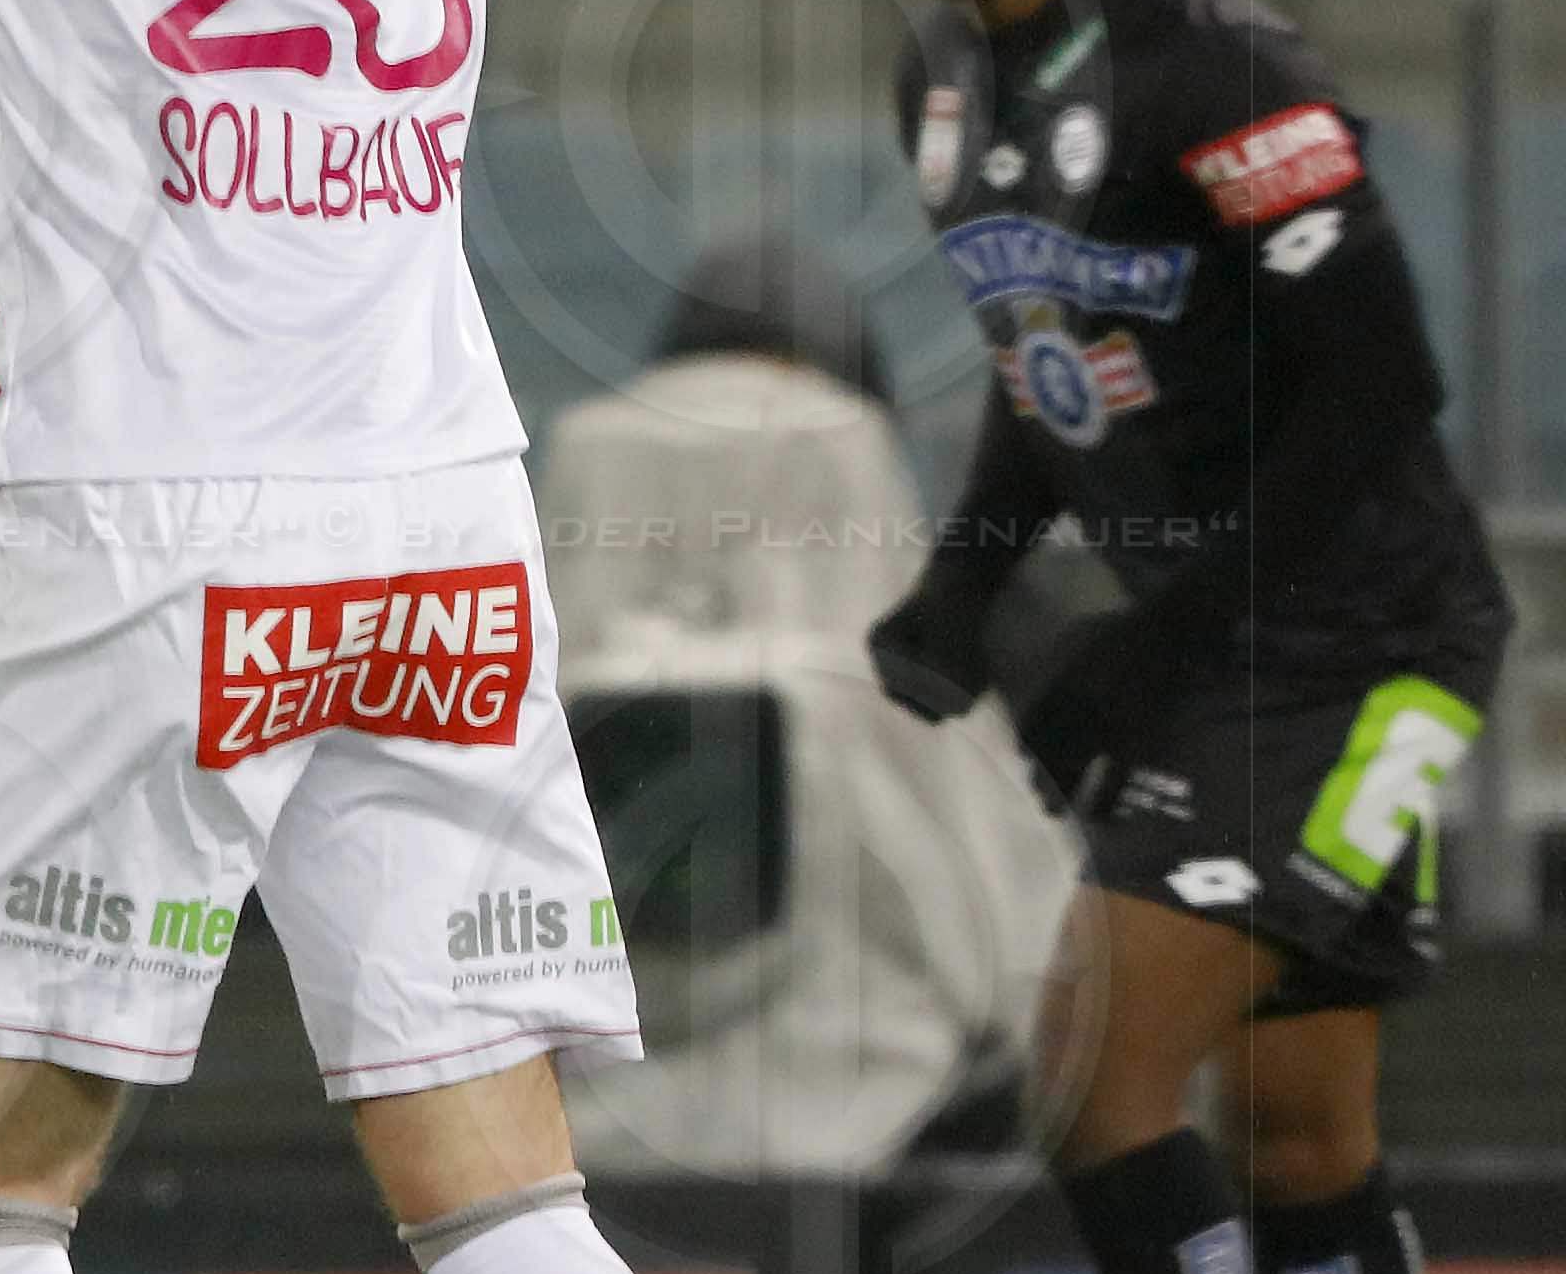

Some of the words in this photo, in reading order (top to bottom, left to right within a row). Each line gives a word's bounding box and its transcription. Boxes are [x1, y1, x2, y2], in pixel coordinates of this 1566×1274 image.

[223, 586, 519, 676] KLEINE
[218, 662, 511, 753] ZEITUNG
[3, 865, 136, 946] altis
[447, 888, 569, 963] altis
[94, 947, 124, 971] by
[451, 963, 535, 994] powered
[541, 960, 567, 983] by
